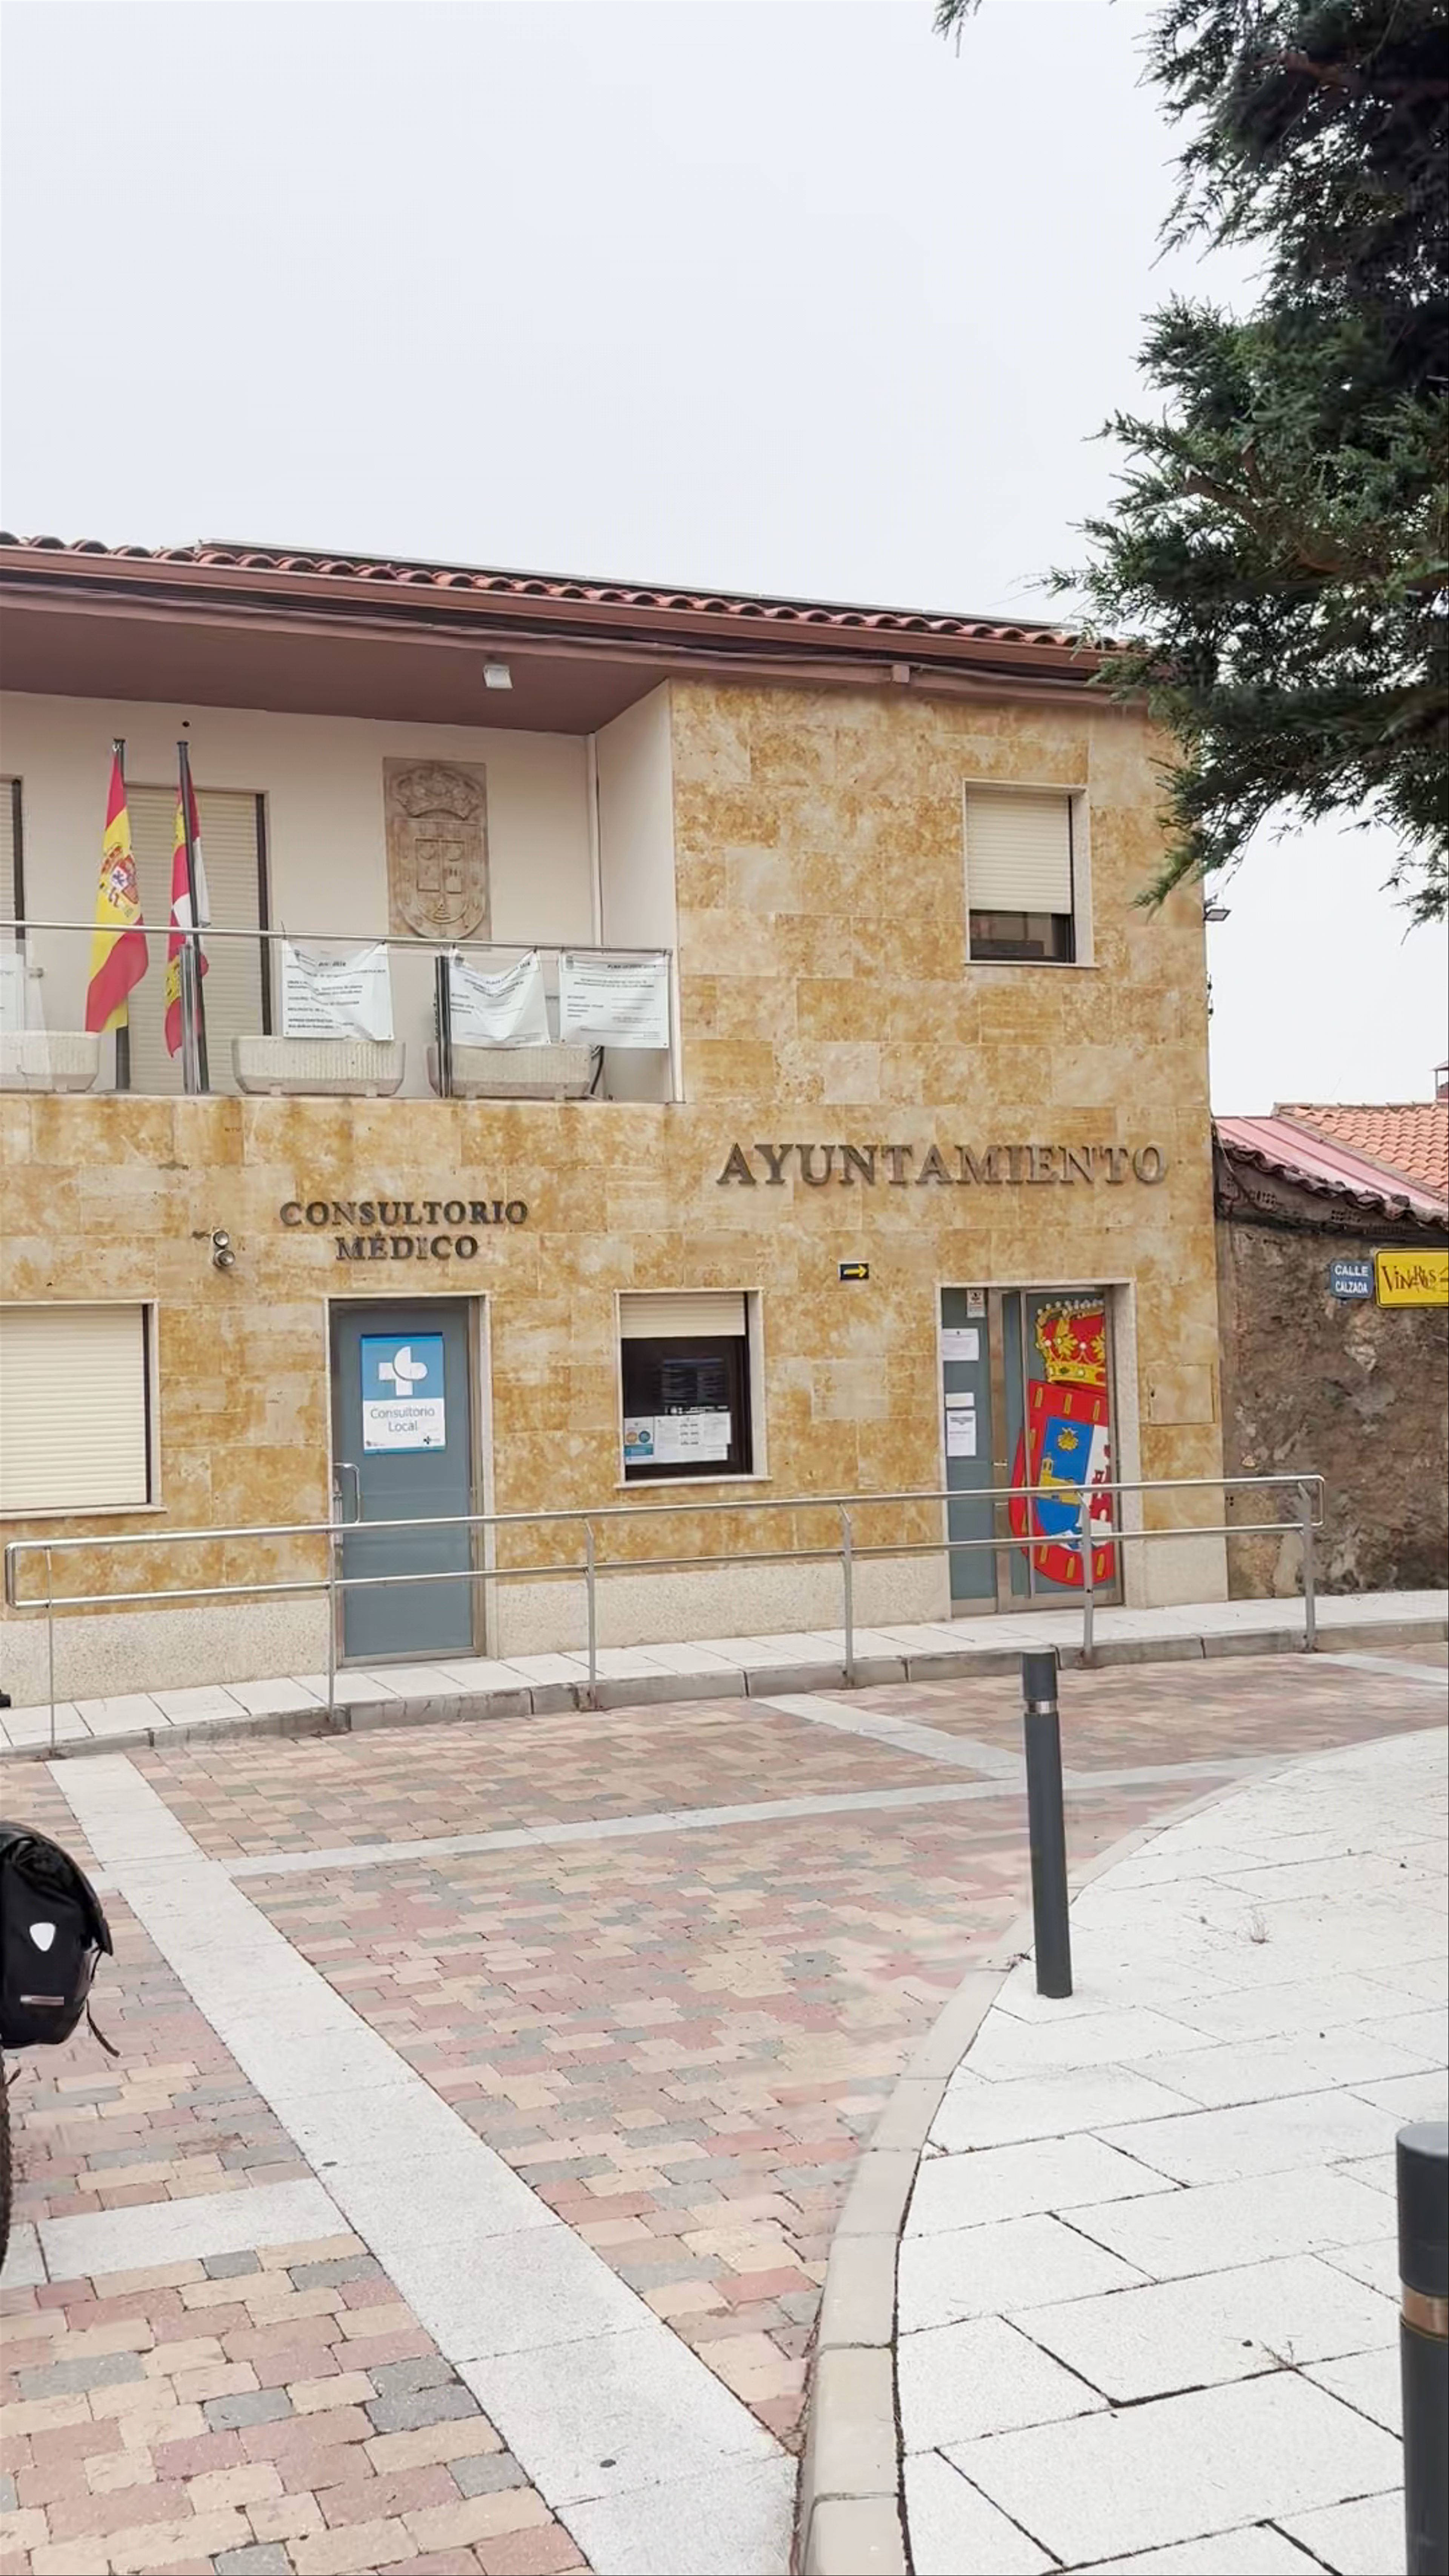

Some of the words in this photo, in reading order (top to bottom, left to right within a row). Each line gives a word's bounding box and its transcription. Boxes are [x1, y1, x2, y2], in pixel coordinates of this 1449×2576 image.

[717, 1142, 1169, 1186] AYUNTAMIENTO
[280, 1200, 528, 1226] CONSULTORIO
[335, 1232, 478, 1260] MÉDICO
[1335, 1264, 1369, 1276] CALLE
[1335, 1281, 1368, 1293] CALZADA
[370, 1406, 435, 1419] Consultorio
[388, 1420, 418, 1432] Local
